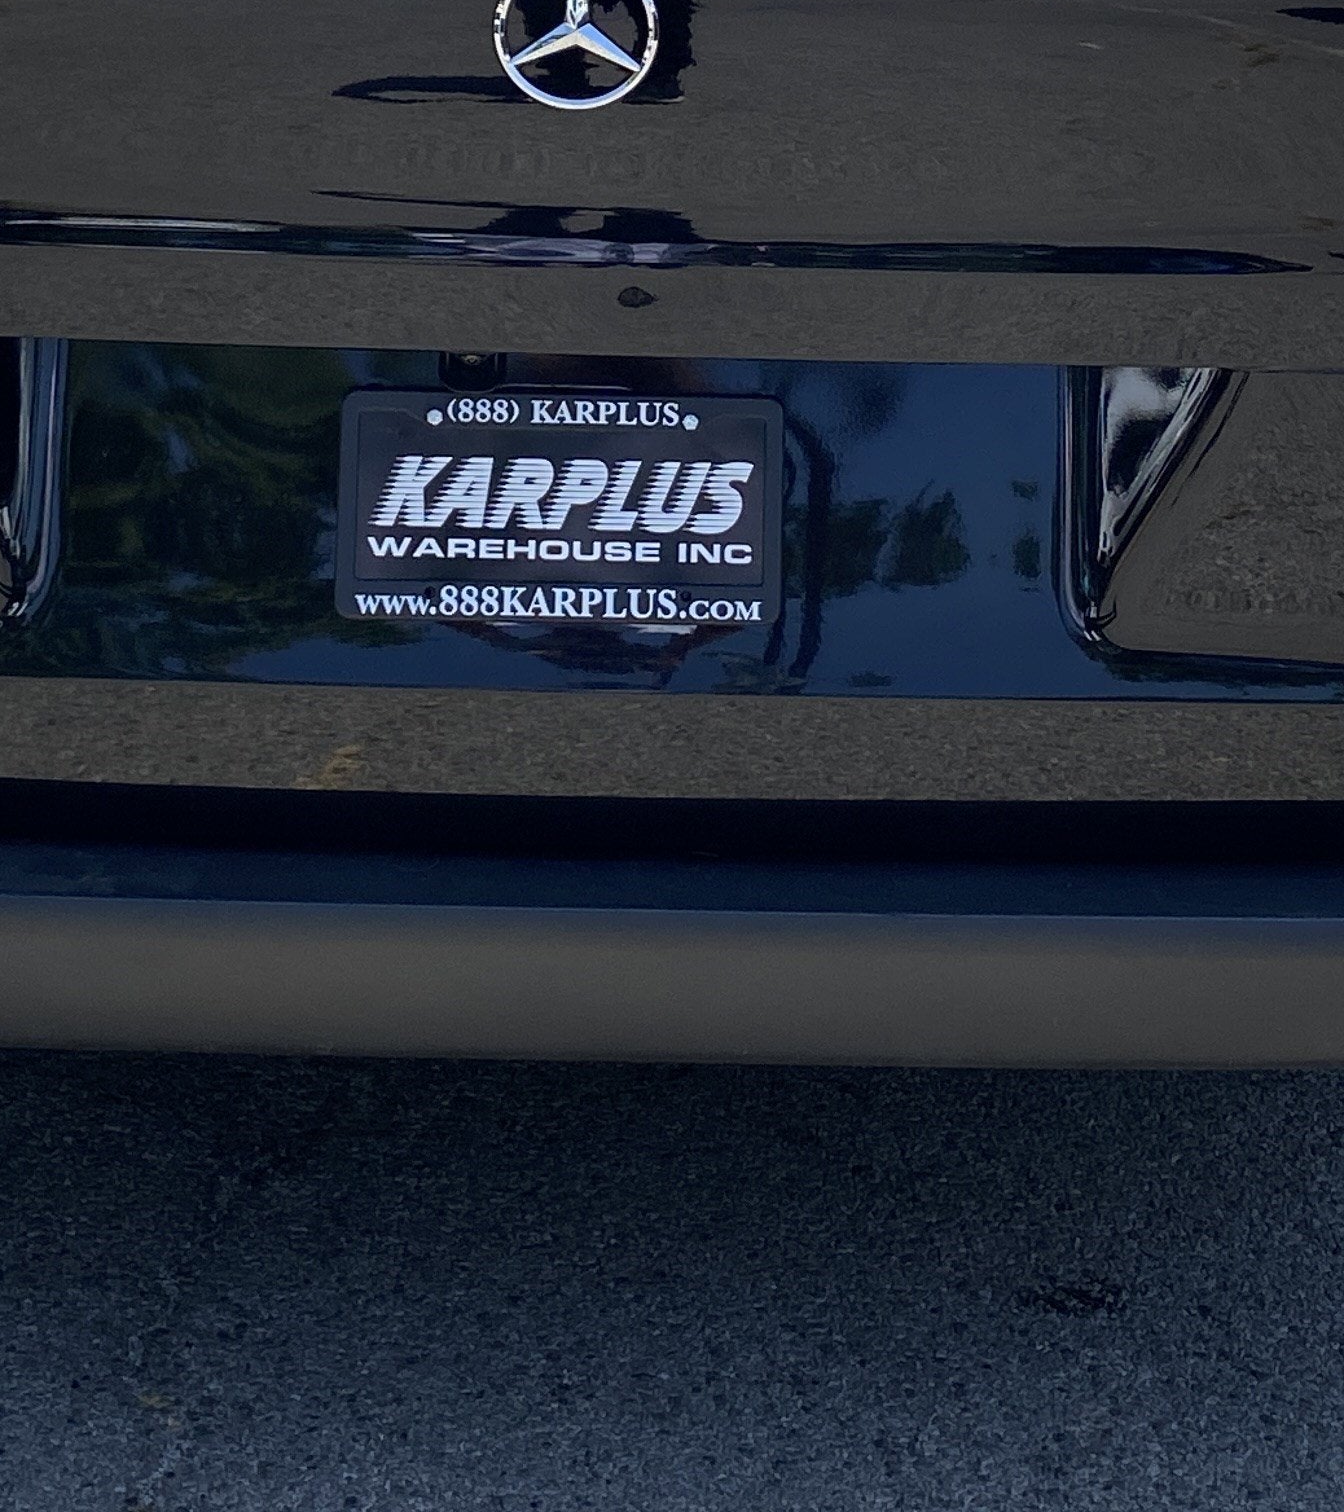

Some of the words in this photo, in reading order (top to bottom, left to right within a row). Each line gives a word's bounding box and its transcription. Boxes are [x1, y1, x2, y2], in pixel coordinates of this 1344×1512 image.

[446, 397, 520, 425] (888)
[531, 400, 680, 427] KARPLUS
[368, 455, 755, 533] KARPLUS
[368, 536, 661, 562] WAREHOUSE
[678, 541, 753, 564] INC
